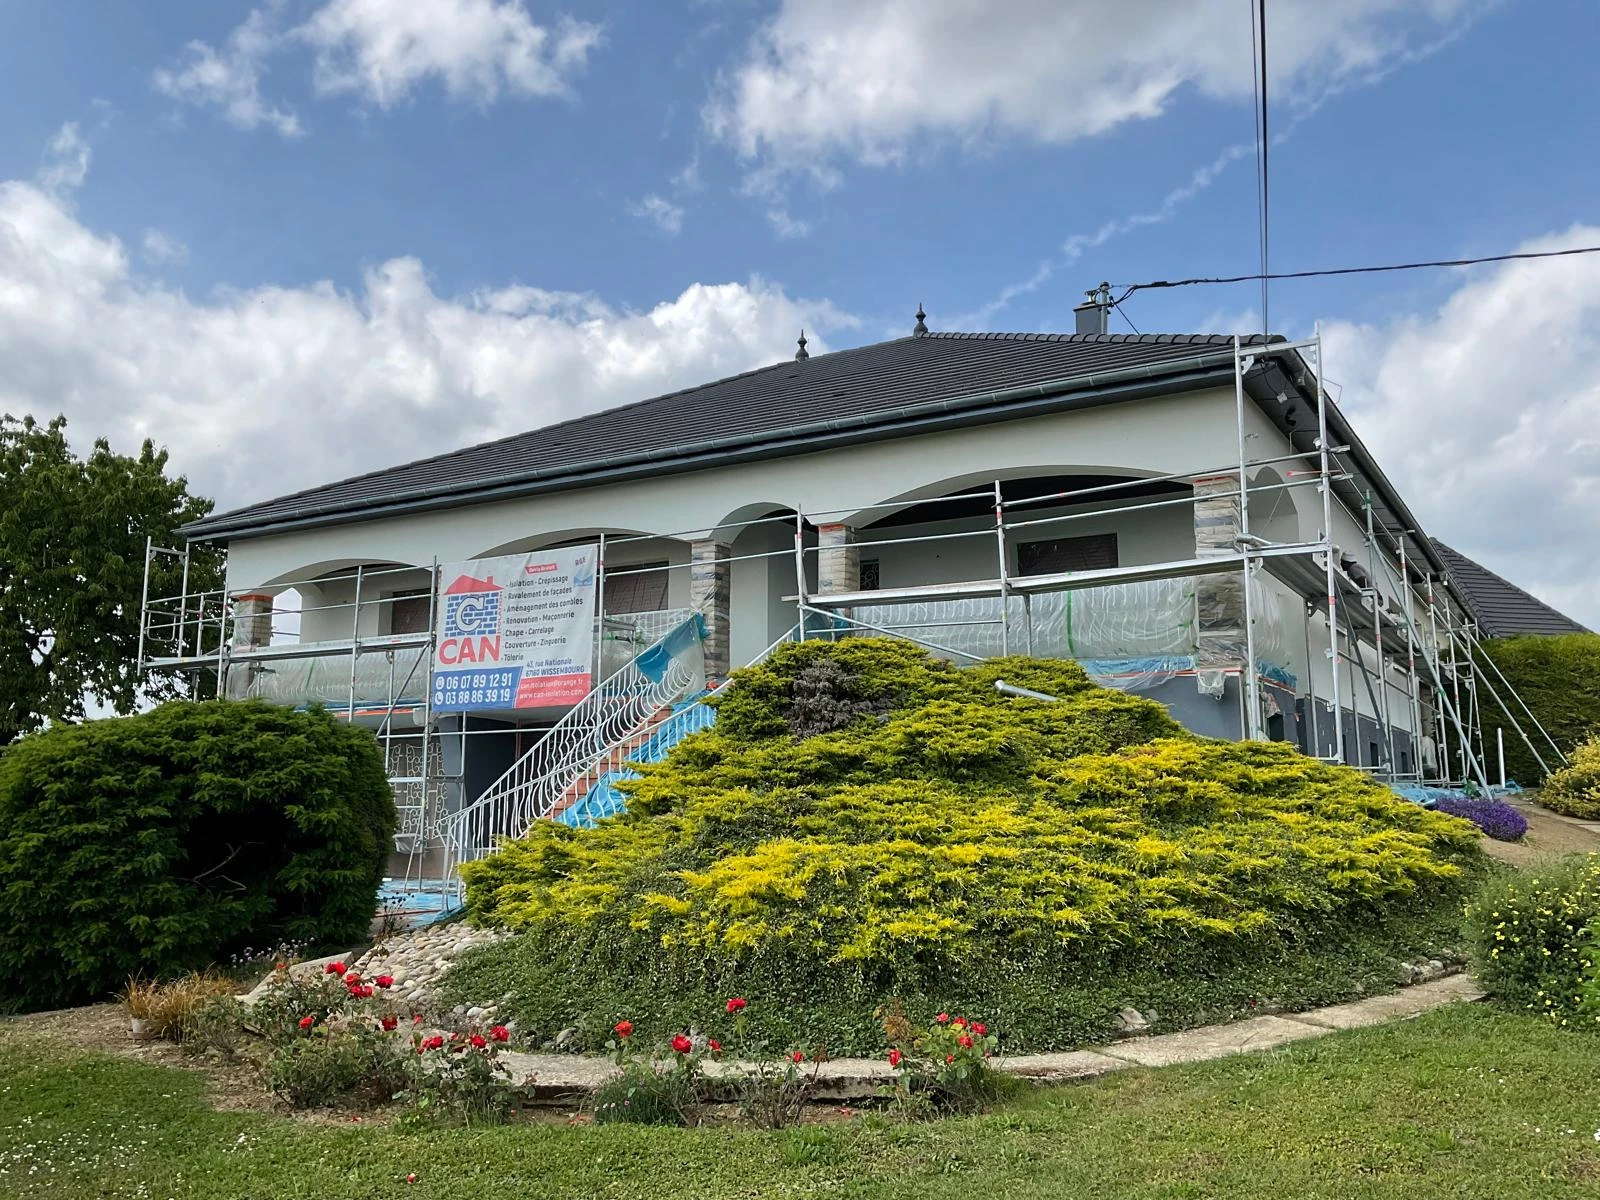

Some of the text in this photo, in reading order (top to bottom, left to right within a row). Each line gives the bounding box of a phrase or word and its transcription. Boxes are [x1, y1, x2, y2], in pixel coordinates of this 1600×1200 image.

[510, 579, 534, 588] Isolation
[508, 587, 572, 600] Ravalement de façades
[560, 598, 583, 607] combles
[543, 611, 574, 622] Maçonnerie
[506, 626, 554, 637] Chape Carrelage
[505, 637, 566, 649] Couverture Zinguerie
[439, 636, 500, 664] CAN
[545, 658, 572, 666] Nationale
[541, 666, 584, 676] WISSEMBOURG
[447, 673, 512, 689] 06 07 89 12 91
[445, 689, 510, 704] 03 88 86 39 19
